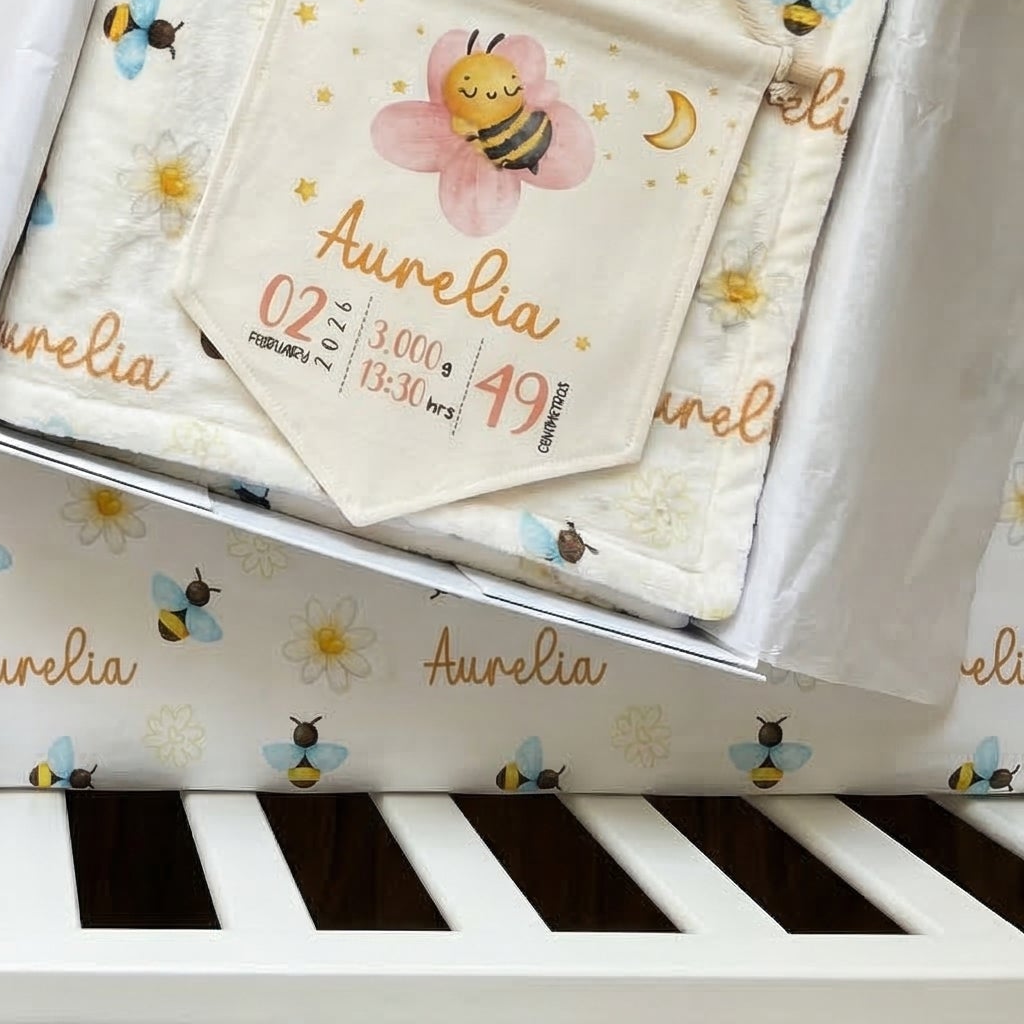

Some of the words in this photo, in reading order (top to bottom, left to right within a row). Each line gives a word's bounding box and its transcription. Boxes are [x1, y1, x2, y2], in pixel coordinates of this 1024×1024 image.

[317, 198, 561, 341] Aurelia
[259, 273, 328, 343] 02
[314, 300, 353, 373] 2026
[367, 319, 443, 371] 3.000
[360, 358, 426, 408] 13:30
[426, 395, 456, 420] hrs
[474, 363, 549, 435] 49
[423, 625, 608, 687] Aurelia
